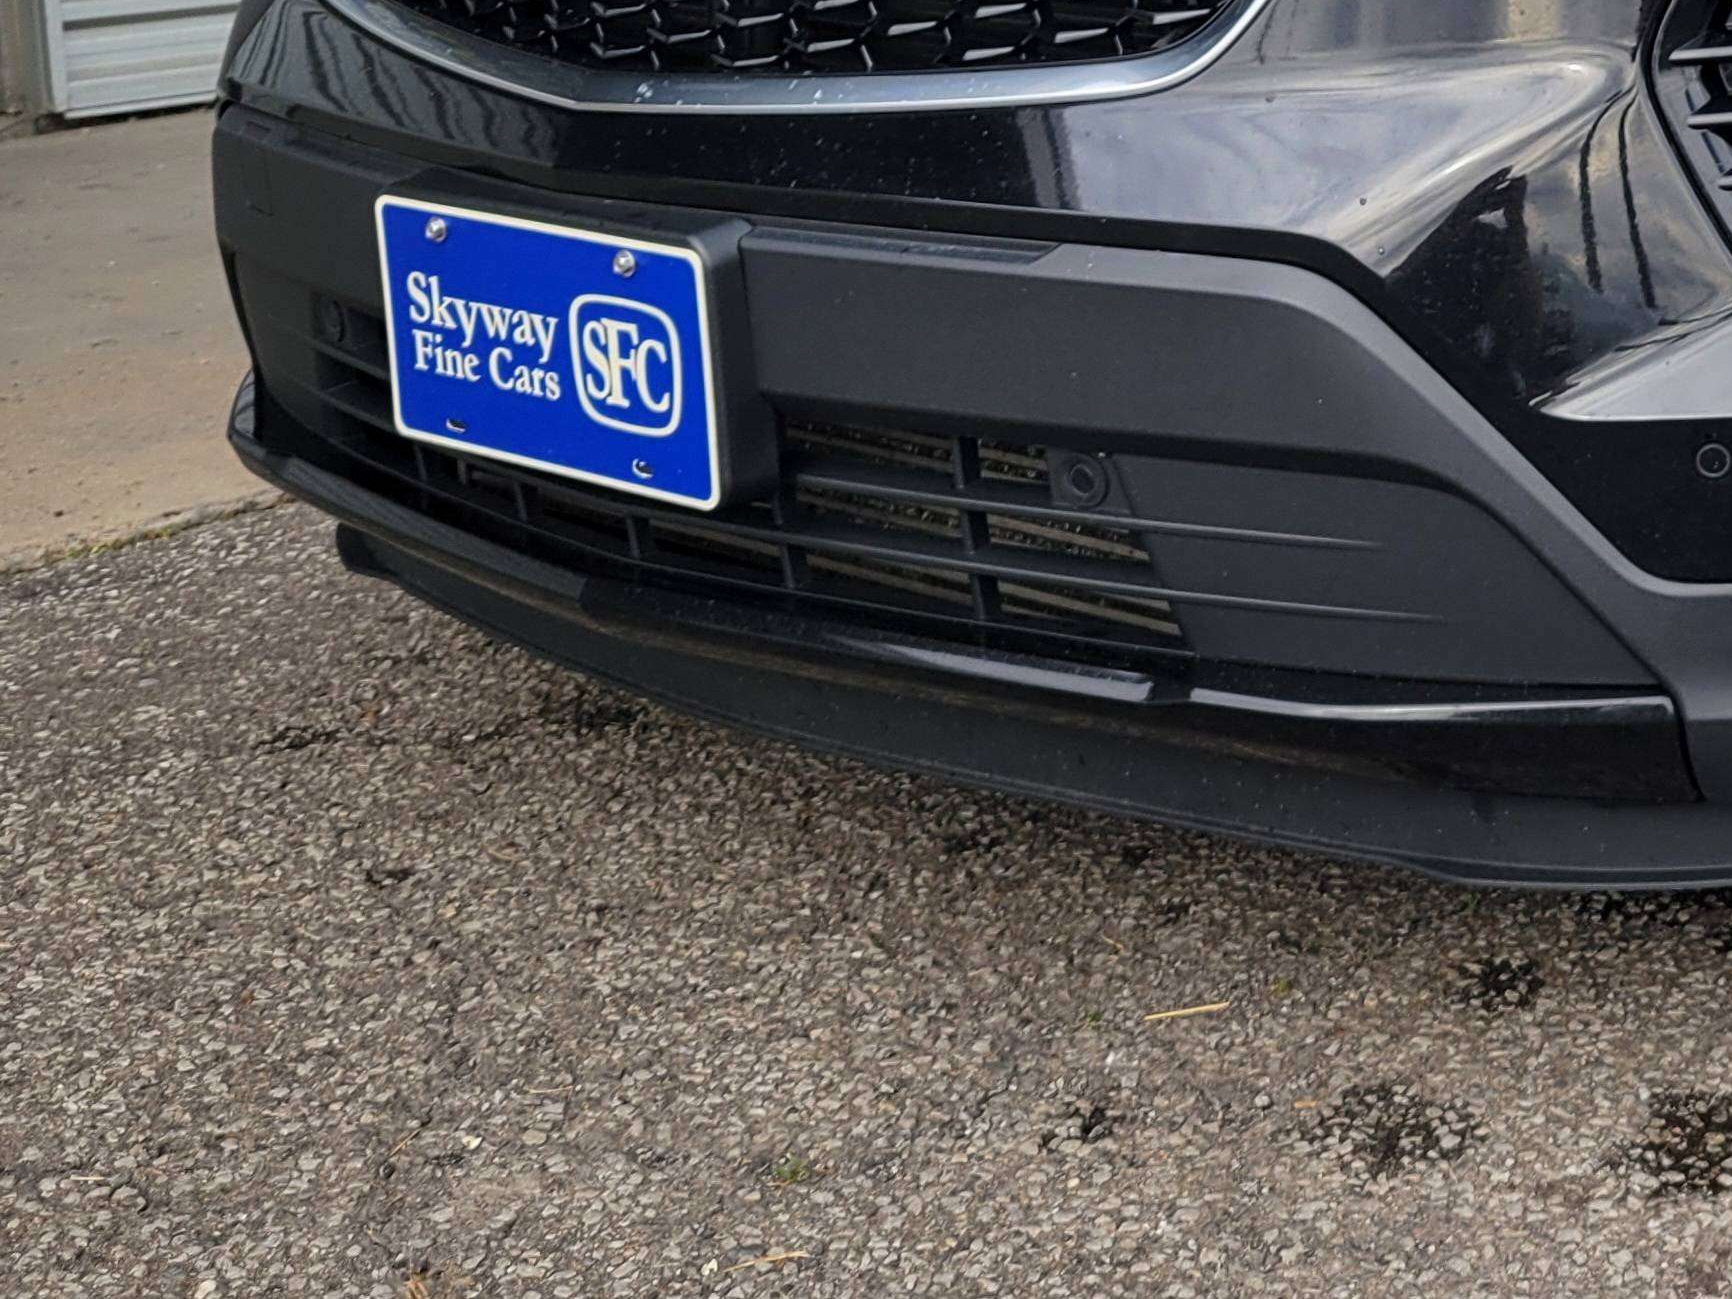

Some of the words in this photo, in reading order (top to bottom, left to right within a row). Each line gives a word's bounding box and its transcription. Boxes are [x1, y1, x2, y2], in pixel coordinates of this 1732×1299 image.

[406, 270, 559, 364] Skyway
[411, 328, 482, 383] Fine
[488, 345, 562, 402] Cars
[582, 316, 671, 414] SFC
